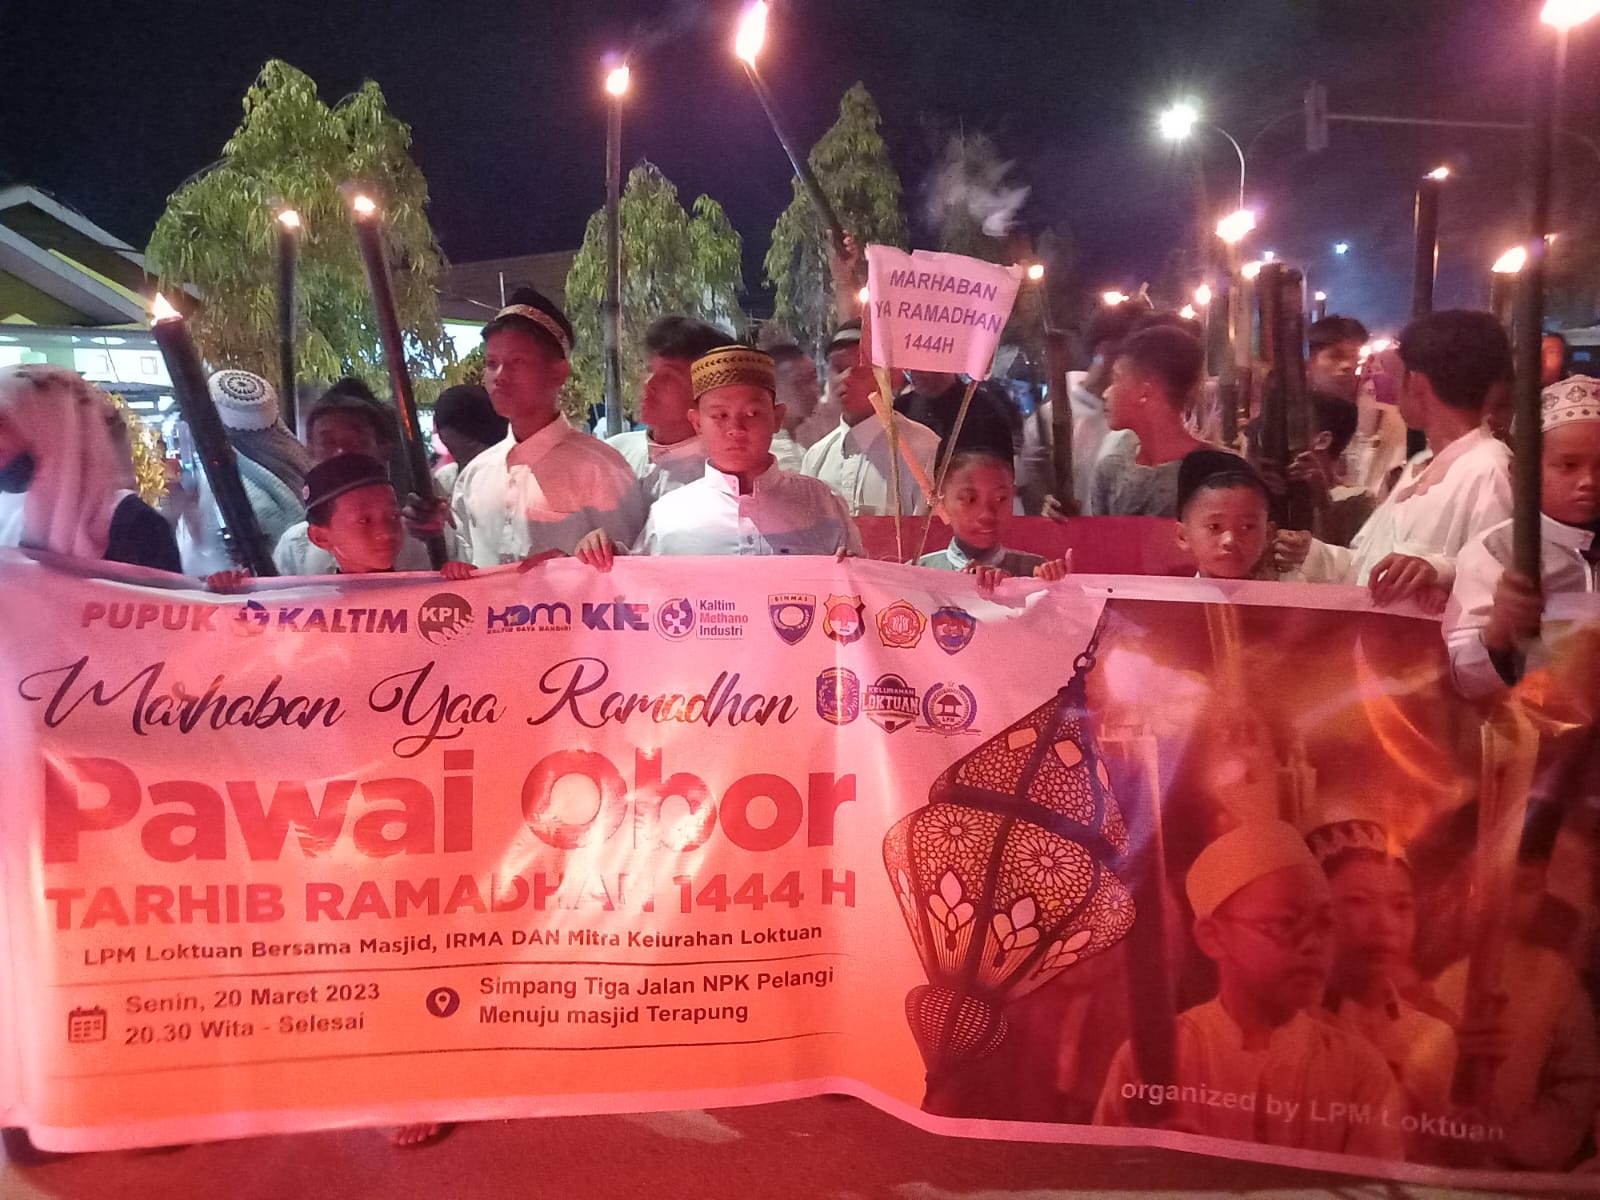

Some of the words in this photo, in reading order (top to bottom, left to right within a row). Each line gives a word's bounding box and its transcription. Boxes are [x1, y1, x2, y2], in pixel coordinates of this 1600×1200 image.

[889, 269, 998, 302] MARHABAN
[875, 301, 892, 319] YA
[897, 301, 1002, 334] RAMADHAN
[903, 333, 955, 354] 1444H
[82, 601, 219, 633] PUPUK
[277, 604, 408, 634] KALTIM
[421, 606, 460, 623] KPI
[699, 599, 736, 612] Kaltim
[699, 612, 749, 624] Methano
[699, 624, 744, 637] Industri
[18, 655, 346, 737] Marhaban
[367, 660, 505, 758] Yaa
[526, 656, 799, 730] Ramadhan
[861, 693, 920, 715] LOKTUAN
[43, 749, 475, 864] Pawai
[521, 746, 857, 853] Obor
[44, 883, 286, 931] TARHIB
[673, 870, 805, 914] 1444
[821, 868, 856, 908] H
[84, 946, 136, 966] LPM
[146, 944, 243, 962] Loktuan
[252, 940, 351, 957] Bersama
[360, 934, 437, 955] Masjid,
[446, 931, 504, 949] IRMA
[511, 928, 560, 946] DAN
[568, 928, 620, 946] Mitra
[740, 926, 823, 945] Loktuan
[125, 992, 206, 1014] Senin,
[213, 989, 243, 1009] 20
[250, 985, 319, 1006] Maret
[326, 982, 381, 1002] 2023
[479, 976, 577, 999] Simpang
[584, 976, 630, 1000] Tiga
[636, 977, 695, 996] Jalan
[703, 973, 750, 993] NPK
[757, 966, 834, 988] Pelangi
[124, 1021, 193, 1046] 20.30
[200, 1019, 255, 1040] Wita
[279, 1012, 365, 1035] Selesai
[479, 1005, 560, 1028] Menuju
[567, 1005, 640, 1029] masjid
[645, 1005, 749, 1025] Terapung
[1120, 1082, 1256, 1114] organized
[1265, 1095, 1300, 1123] by
[1309, 1099, 1371, 1126] LPM
